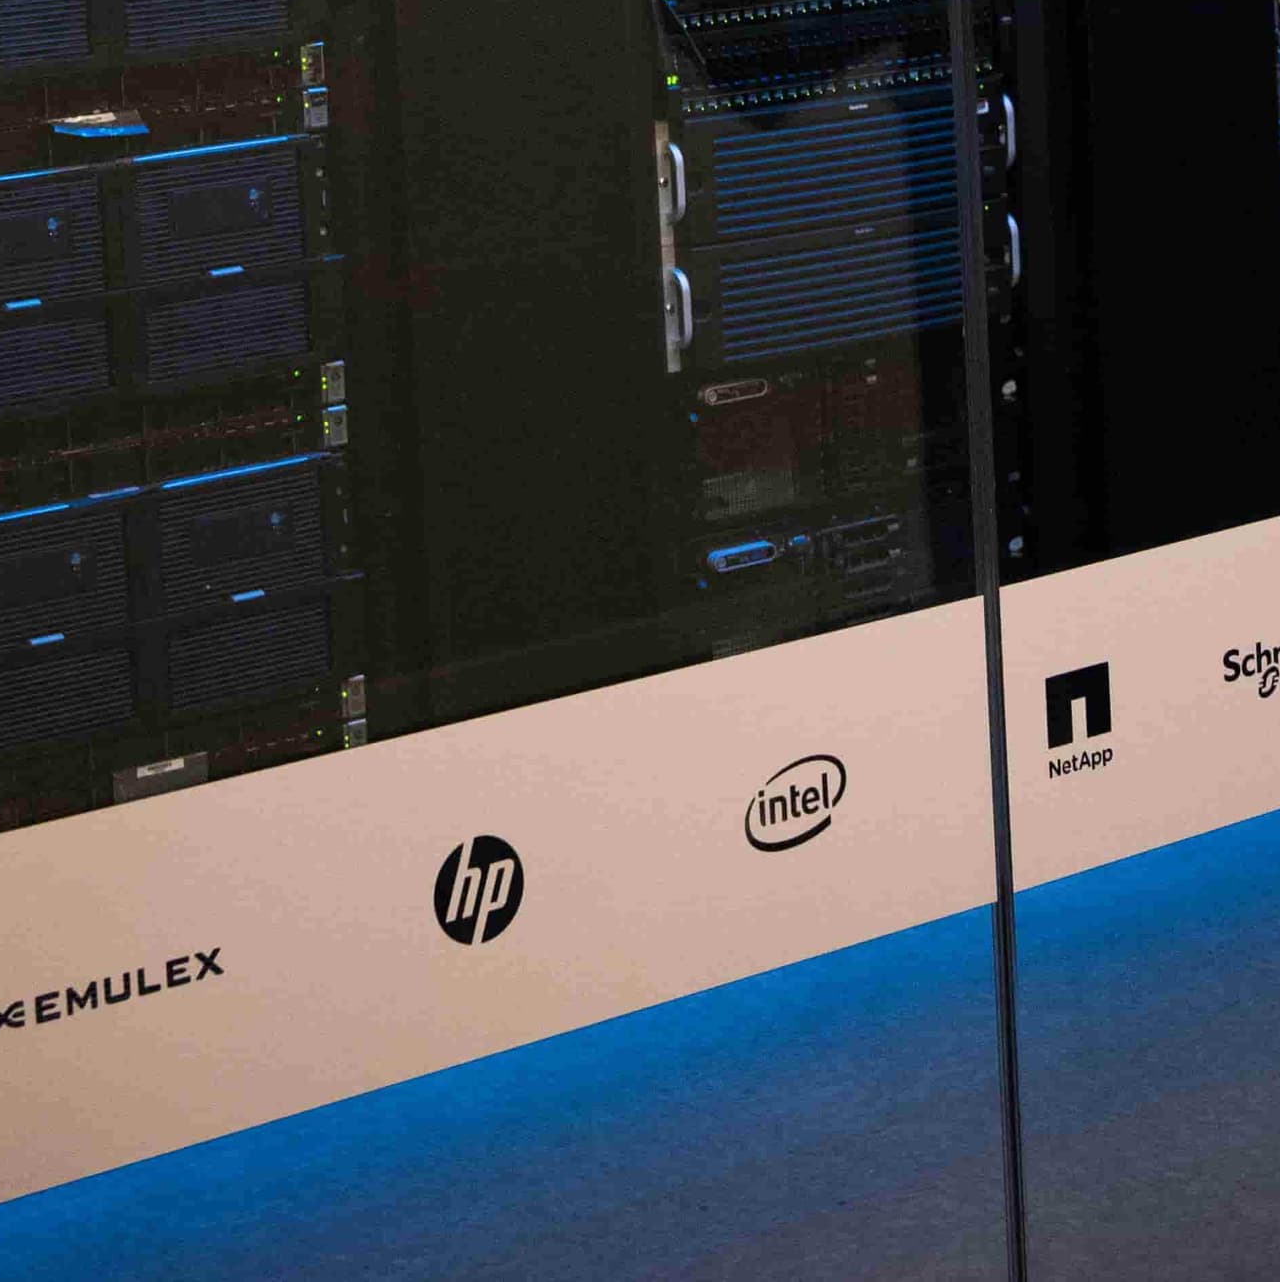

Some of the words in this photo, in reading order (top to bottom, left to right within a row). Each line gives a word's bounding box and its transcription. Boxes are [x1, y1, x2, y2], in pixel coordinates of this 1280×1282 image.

[1048, 747, 1113, 779] NetApp
[758, 771, 830, 827] intel
[439, 835, 519, 946] hp
[34, 947, 224, 1024] EMULEX
